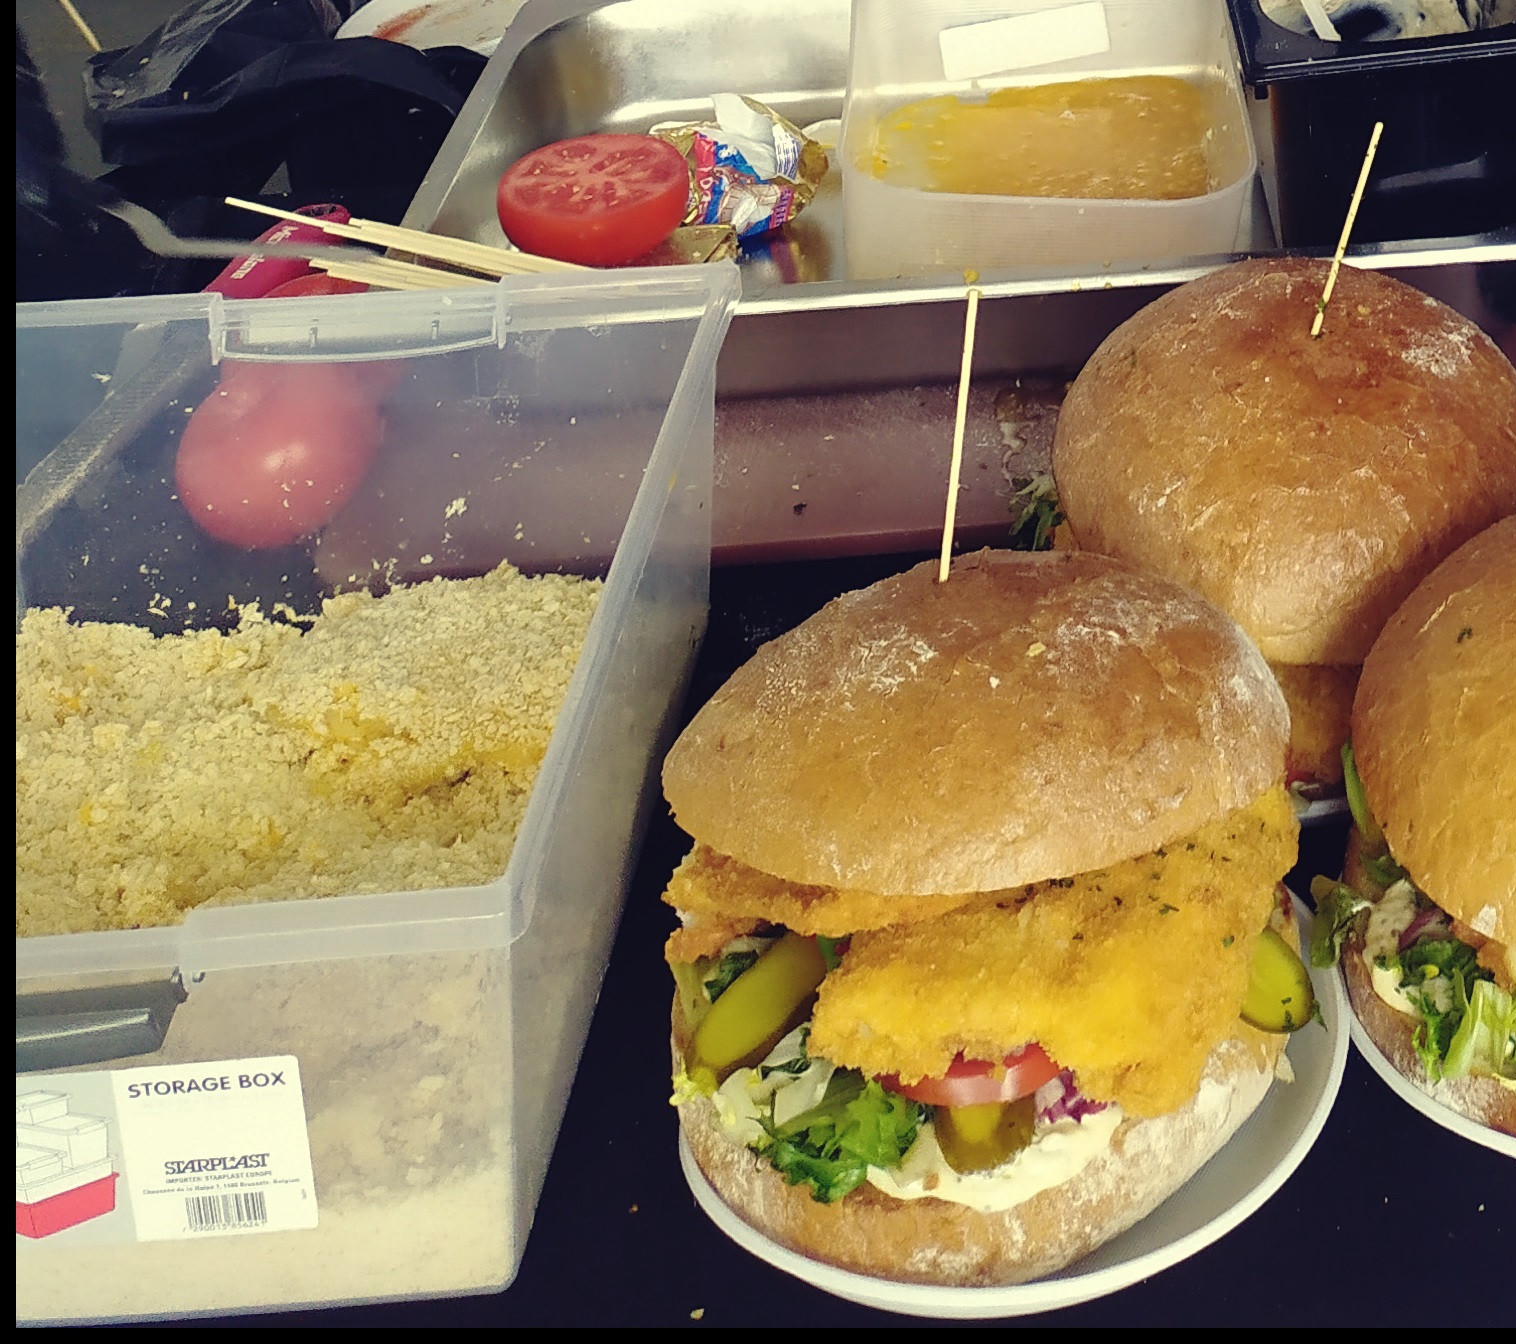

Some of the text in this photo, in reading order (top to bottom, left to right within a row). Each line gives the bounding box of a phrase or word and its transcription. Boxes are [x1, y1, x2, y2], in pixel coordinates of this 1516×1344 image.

[128, 1071, 286, 1098] STORAGE BOX
[164, 1153, 270, 1175] STARPLAST
